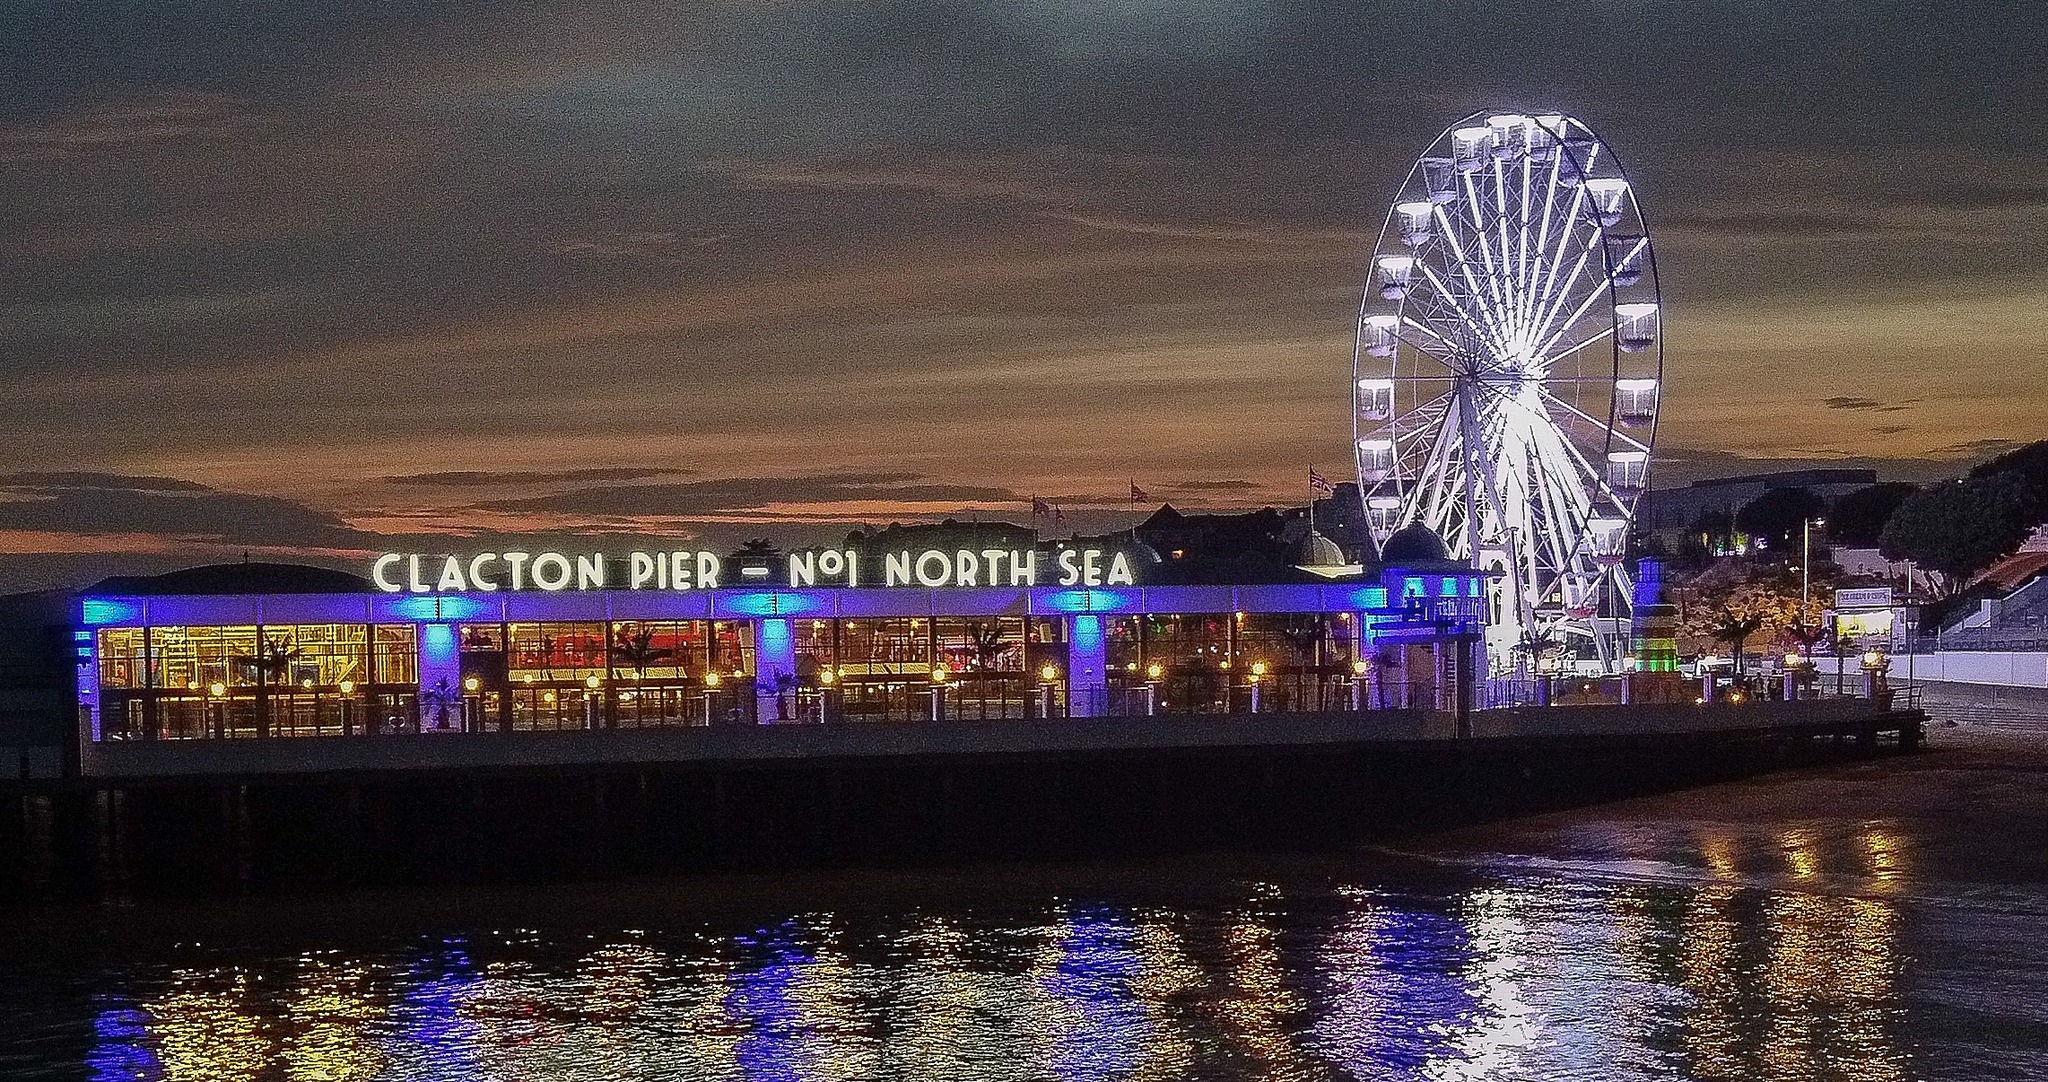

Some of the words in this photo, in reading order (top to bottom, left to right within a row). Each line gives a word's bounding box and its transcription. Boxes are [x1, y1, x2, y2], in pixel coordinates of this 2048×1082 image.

[372, 552, 605, 590] CLACTON
[629, 550, 722, 590] PIER
[884, 549, 1037, 588] NORTH
[1057, 549, 1134, 587] SEA
